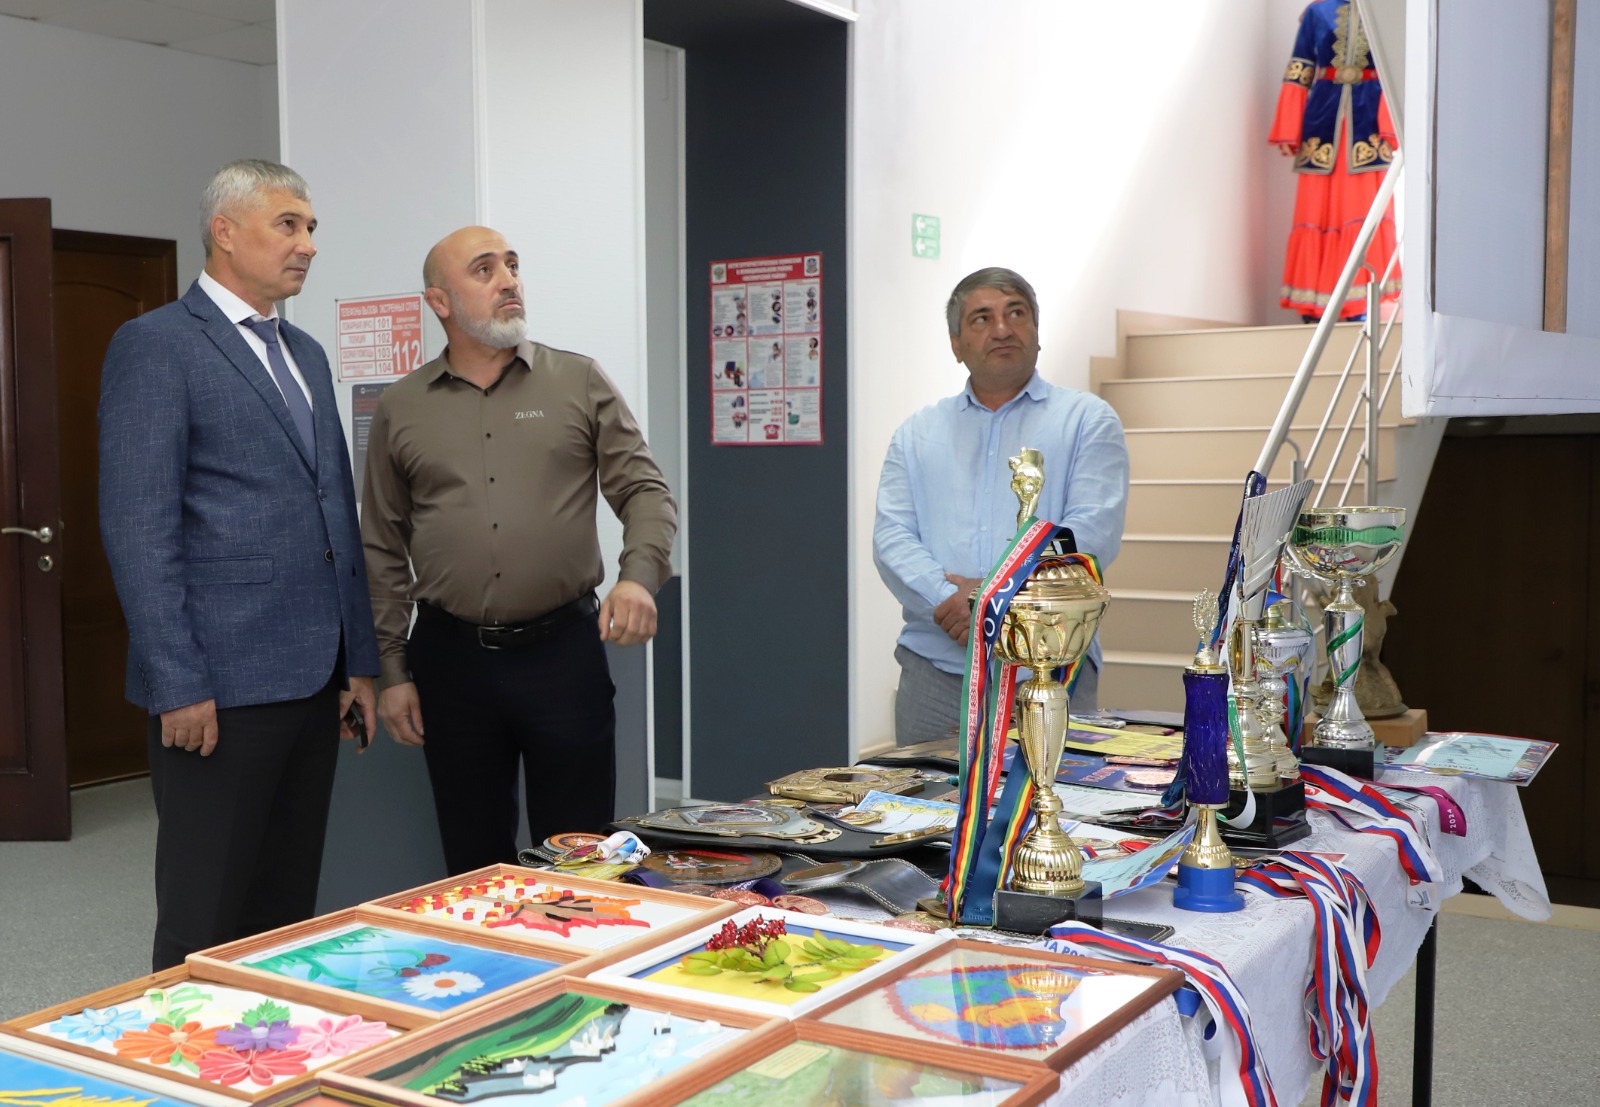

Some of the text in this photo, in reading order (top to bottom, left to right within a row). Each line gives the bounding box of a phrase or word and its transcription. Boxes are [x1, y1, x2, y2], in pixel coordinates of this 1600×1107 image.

[377, 318, 391, 331] 101
[378, 333, 391, 344] 102
[378, 347, 391, 359] 103
[394, 339, 422, 372] 112
[379, 361, 392, 373] 104
[515, 410, 544, 420] ZEGNA
[1446, 808, 1457, 829] 2024
